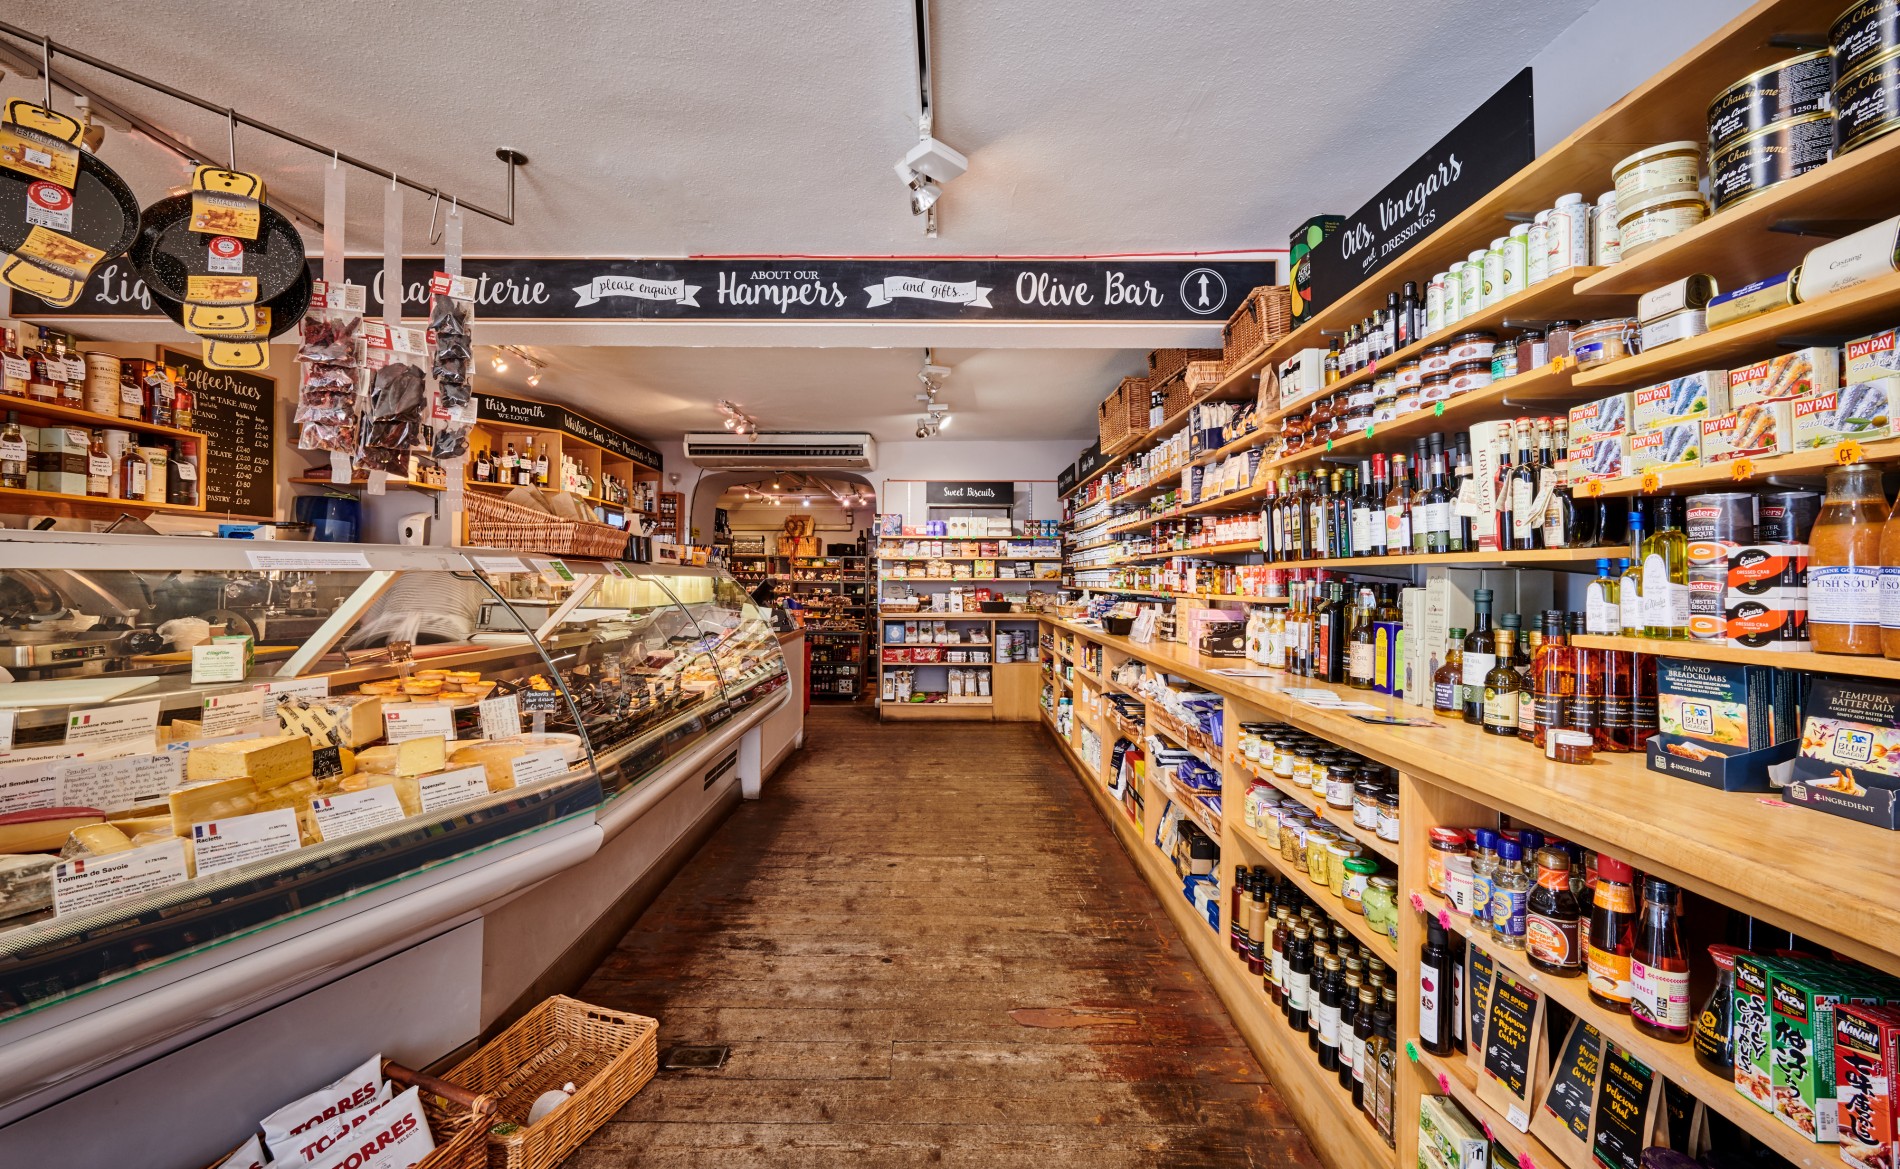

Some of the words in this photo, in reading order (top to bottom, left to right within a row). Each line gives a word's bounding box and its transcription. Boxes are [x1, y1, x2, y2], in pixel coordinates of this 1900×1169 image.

[1793, 104, 1812, 114] 1250
[1728, 146, 1788, 164] Chaurienne
[1342, 221, 1375, 260] Oils,
[1379, 153, 1463, 232] Vinegars
[1362, 249, 1377, 269] and
[1380, 209, 1436, 258] DRESSINGS
[1829, 252, 1863, 270] Castaing
[750, 270, 791, 280] ABOUT
[795, 270, 820, 280] OUR
[599, 278, 635, 294] please
[639, 281, 678, 297] enquire
[717, 271, 847, 314] Hampers
[1016, 271, 1094, 307] Olive
[1104, 270, 1164, 308] Bar
[367, 336, 385, 344] Dried
[1850, 343, 1870, 358] PAY
[1871, 335, 1893, 352] PAY
[182, 364, 224, 391] Coffee
[225, 375, 262, 400] Prices
[1732, 371, 1748, 385] PAY
[1749, 365, 1767, 380] PAY
[199, 392, 209, 400] IN
[217, 396, 237, 407] TAKE
[238, 401, 258, 412] AWAY
[1638, 392, 1653, 404] PAY
[1653, 386, 1670, 399] PAY
[485, 397, 508, 412] this
[510, 404, 546, 418] month
[1796, 401, 1814, 416] PAY
[1815, 394, 1836, 411] PAY
[510, 414, 530, 422] LOVE
[1572, 409, 1584, 421] PAY
[1584, 406, 1597, 418] PAY
[564, 413, 588, 436] Whiskies
[593, 427, 605, 444] Gins
[1705, 420, 1719, 433] PAY
[1720, 415, 1735, 429] PAY
[1633, 437, 1646, 449] PAY
[1647, 433, 1663, 446] PAY
[1570, 449, 1581, 460] PAY
[1581, 447, 1593, 458] PAY
[1840, 449, 1853, 461] GF
[1737, 464, 1746, 475] GF
[1479, 449, 1491, 514] LEONARDI
[1645, 478, 1653, 487] GF
[207, 495, 231, 503] PASTRY
[943, 487, 964, 497] Sweet
[967, 487, 996, 498] Biscuits
[1687, 508, 1720, 519] Baxters
[1740, 555, 1766, 569] Epicure
[1689, 582, 1721, 592] Baxters
[1817, 580, 1840, 588] FISH
[1843, 580, 1878, 588] SOUP
[1691, 603, 1716, 611] BISQUE
[1738, 607, 1765, 621] Epicure
[1668, 669, 1727, 682] BREADCRUMBS
[1683, 664, 1711, 674] PANKO
[1839, 690, 1890, 704] TEMPURA
[1831, 697, 1869, 710] BATTER
[1872, 703, 1896, 713] MIX
[70, 722, 99, 730] Provolone
[1685, 716, 1709, 726] BLUE
[1836, 749, 1865, 758] DRAGON
[1838, 742, 1866, 753] BLUE
[8, 777, 39, 788] Smoked
[422, 782, 446, 790] Appenzeller
[316, 806, 335, 814] Morbier
[196, 835, 222, 843] Raclette
[57, 872, 88, 883] Tomme
[102, 863, 129, 874] Savoie
[1474, 961, 1484, 972] SRI
[1743, 963, 1758, 973] S&B
[1636, 984, 1654, 996] SAUCE
[1780, 983, 1797, 994] S&B
[1499, 988, 1510, 999] SRI
[1511, 995, 1529, 1011] SPICE
[1494, 1005, 1528, 1032] Cardamom
[1846, 1014, 1867, 1027] S&B
[1498, 1018, 1526, 1043] Peppers
[1584, 1023, 1599, 1035] SRI
[1498, 1029, 1518, 1049] Curry
[1572, 1066, 1596, 1091] Curry
[1609, 1062, 1623, 1077] SRI
[1622, 1071, 1644, 1091] SPICE
[1606, 1083, 1639, 1115] Delicious
[290, 1081, 376, 1136] TORRES
[1611, 1100, 1629, 1120] Dhal
[397, 1127, 420, 1145] SELECTA
